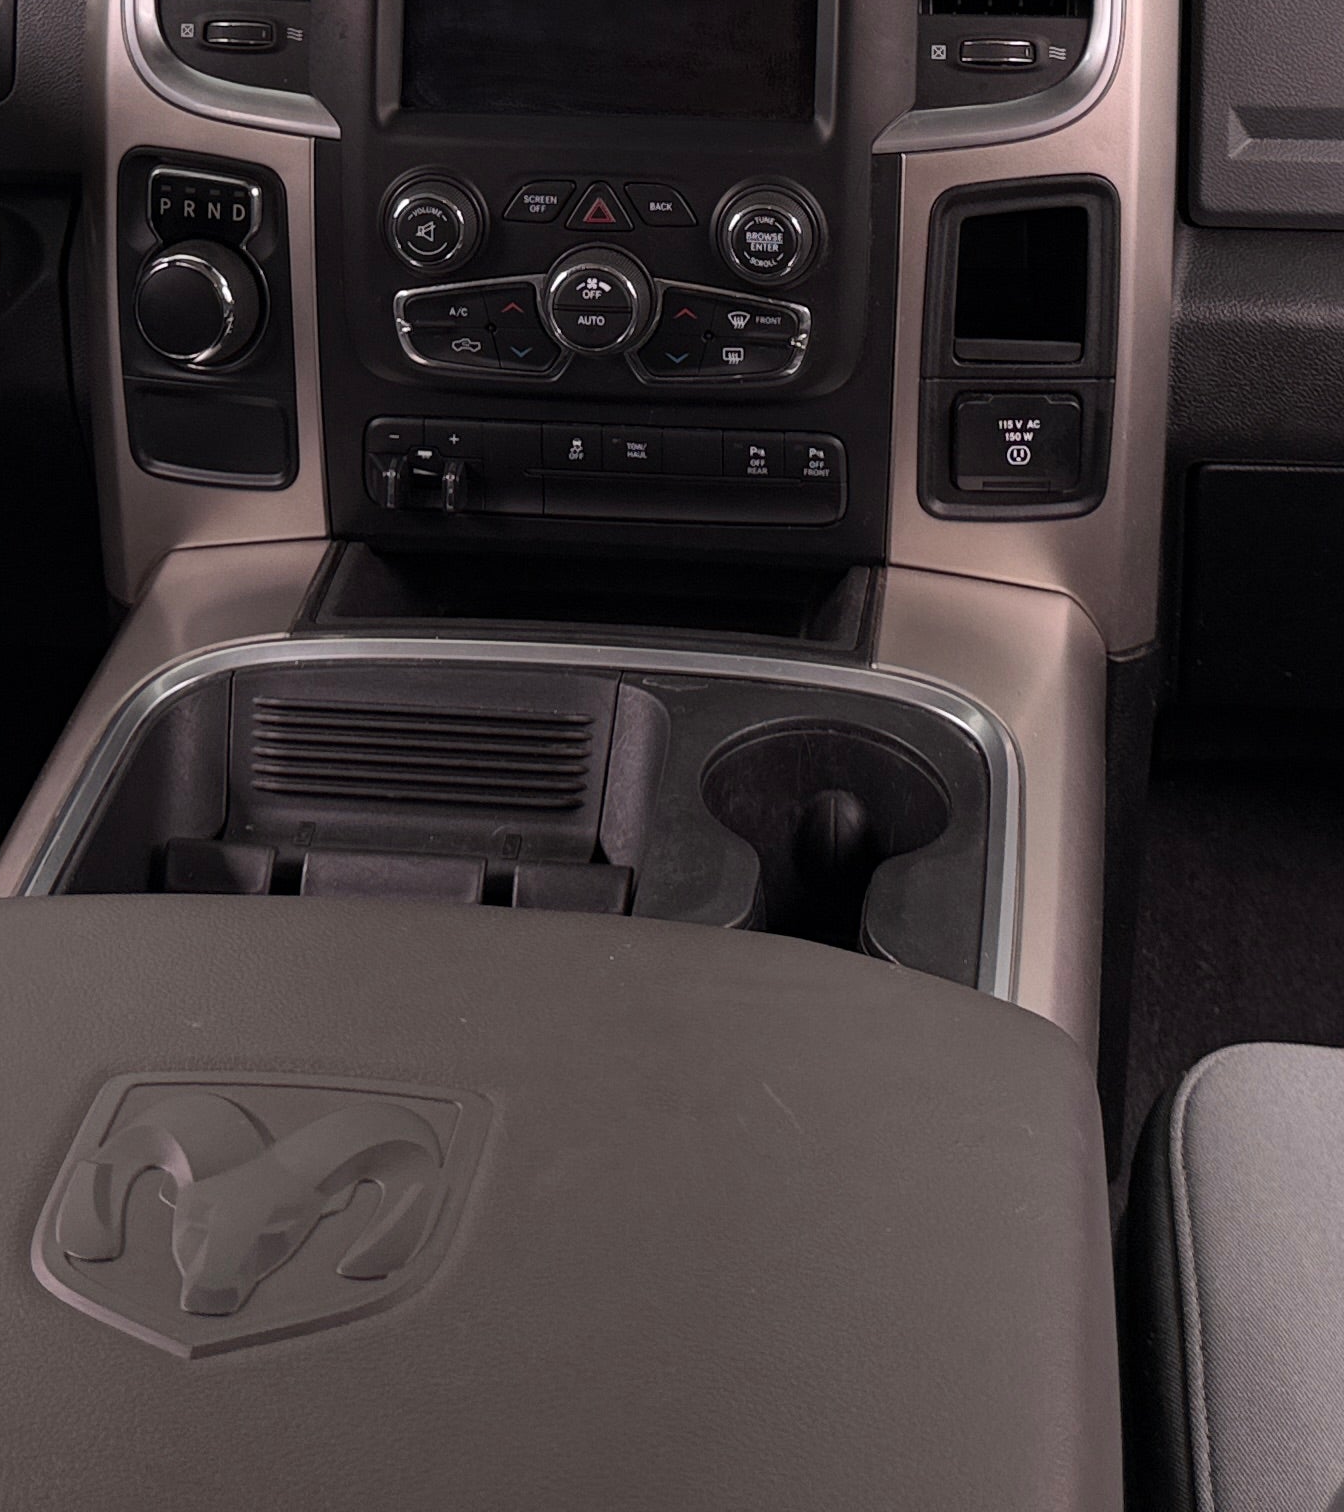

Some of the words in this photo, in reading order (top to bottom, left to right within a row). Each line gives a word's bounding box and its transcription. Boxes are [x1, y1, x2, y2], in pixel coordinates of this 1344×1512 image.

[523, 194, 557, 205] SCREEN
[160, 197, 171, 215] P
[183, 199, 196, 218] R
[207, 201, 221, 220] N
[232, 203, 246, 221] D
[412, 206, 443, 218] VOLUME
[529, 204, 547, 213] OFF
[649, 202, 673, 212] BACK
[754, 216, 776, 225] TUNE
[745, 231, 784, 241] BROWSE
[750, 242, 779, 252] ENTER
[748, 256, 778, 268] SCROLL
[582, 290, 602, 300] OFF
[449, 306, 469, 317] A/C
[577, 315, 605, 326] AUTO
[756, 315, 782, 325] FRONT
[998, 419, 1013, 430] 115
[1015, 419, 1023, 430] V
[1026, 419, 1041, 429] AC
[1005, 431, 1022, 442] 150
[1022, 431, 1034, 442] W
[749, 458, 765, 467] OFF
[808, 460, 825, 469] OFF
[747, 467, 768, 475] REAR
[803, 468, 830, 477] FRONT
